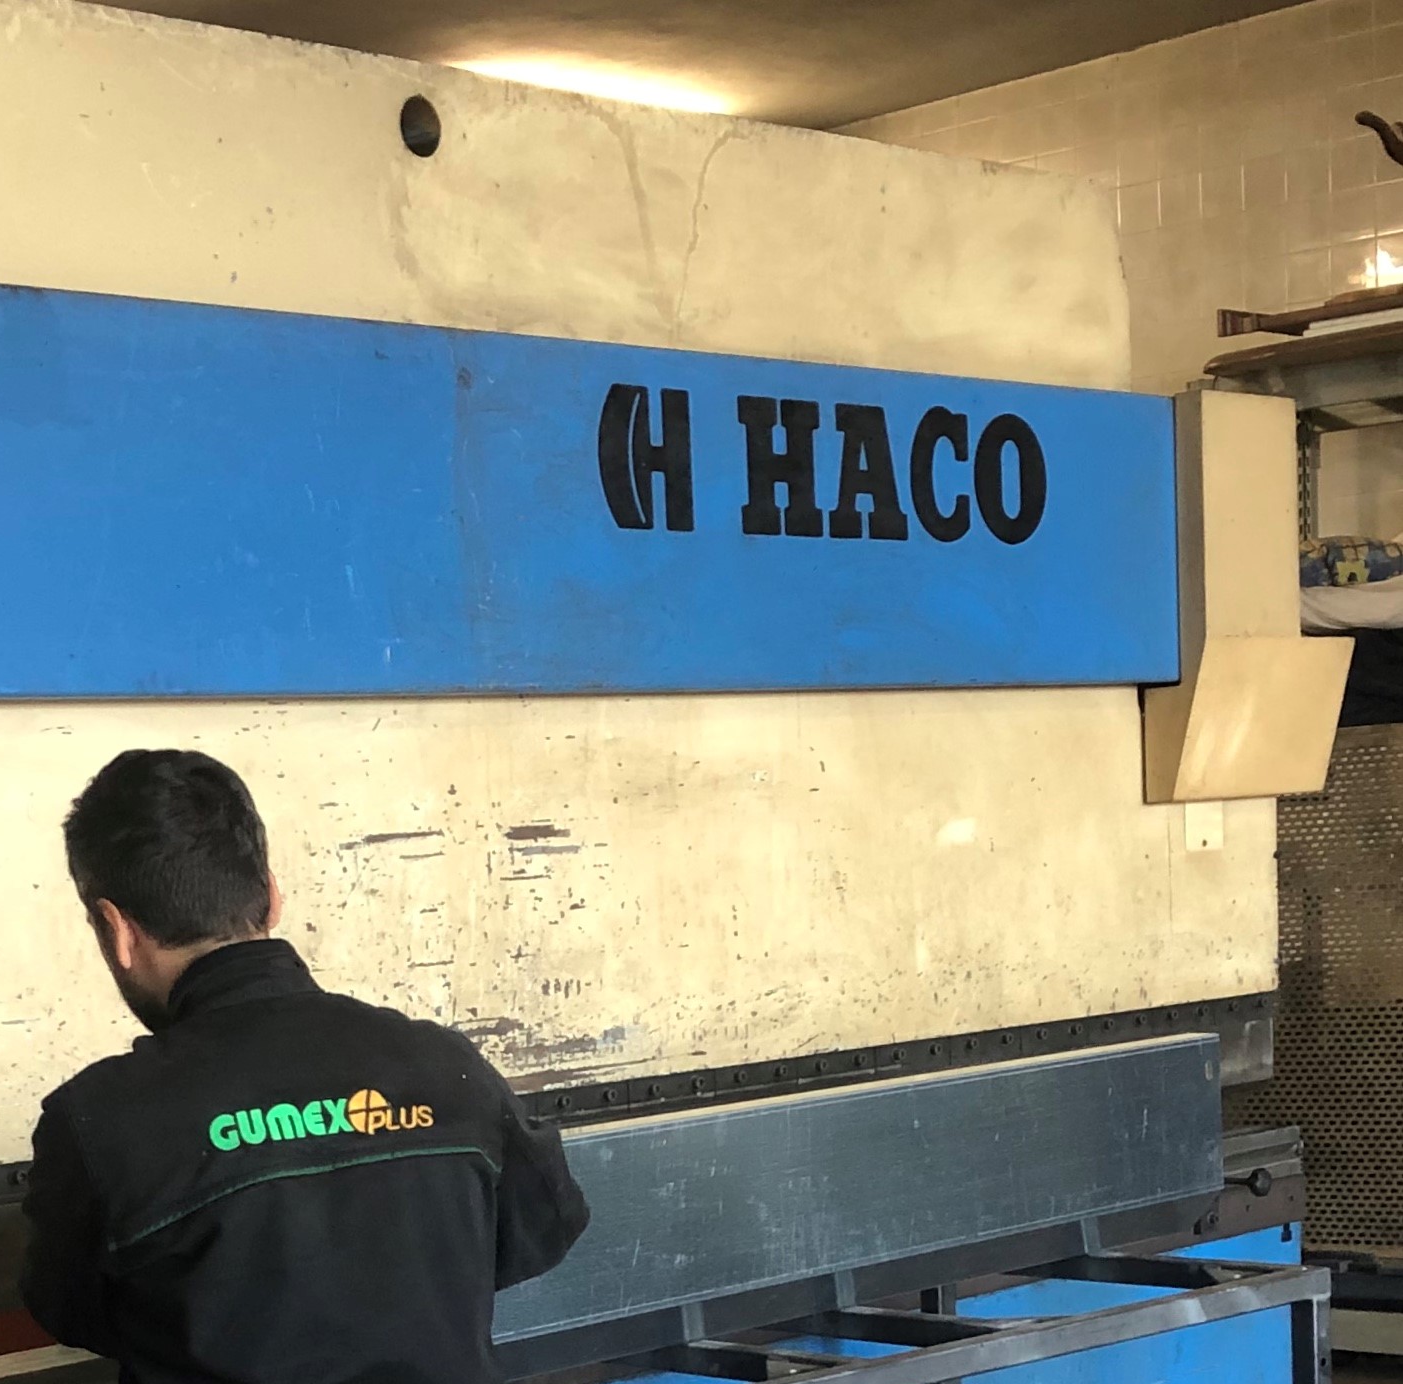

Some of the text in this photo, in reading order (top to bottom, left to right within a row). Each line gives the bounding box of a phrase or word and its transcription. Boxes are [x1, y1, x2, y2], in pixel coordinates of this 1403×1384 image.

[737, 395, 1047, 545] HACO
[209, 1098, 434, 1151] GUMEX PLUS
